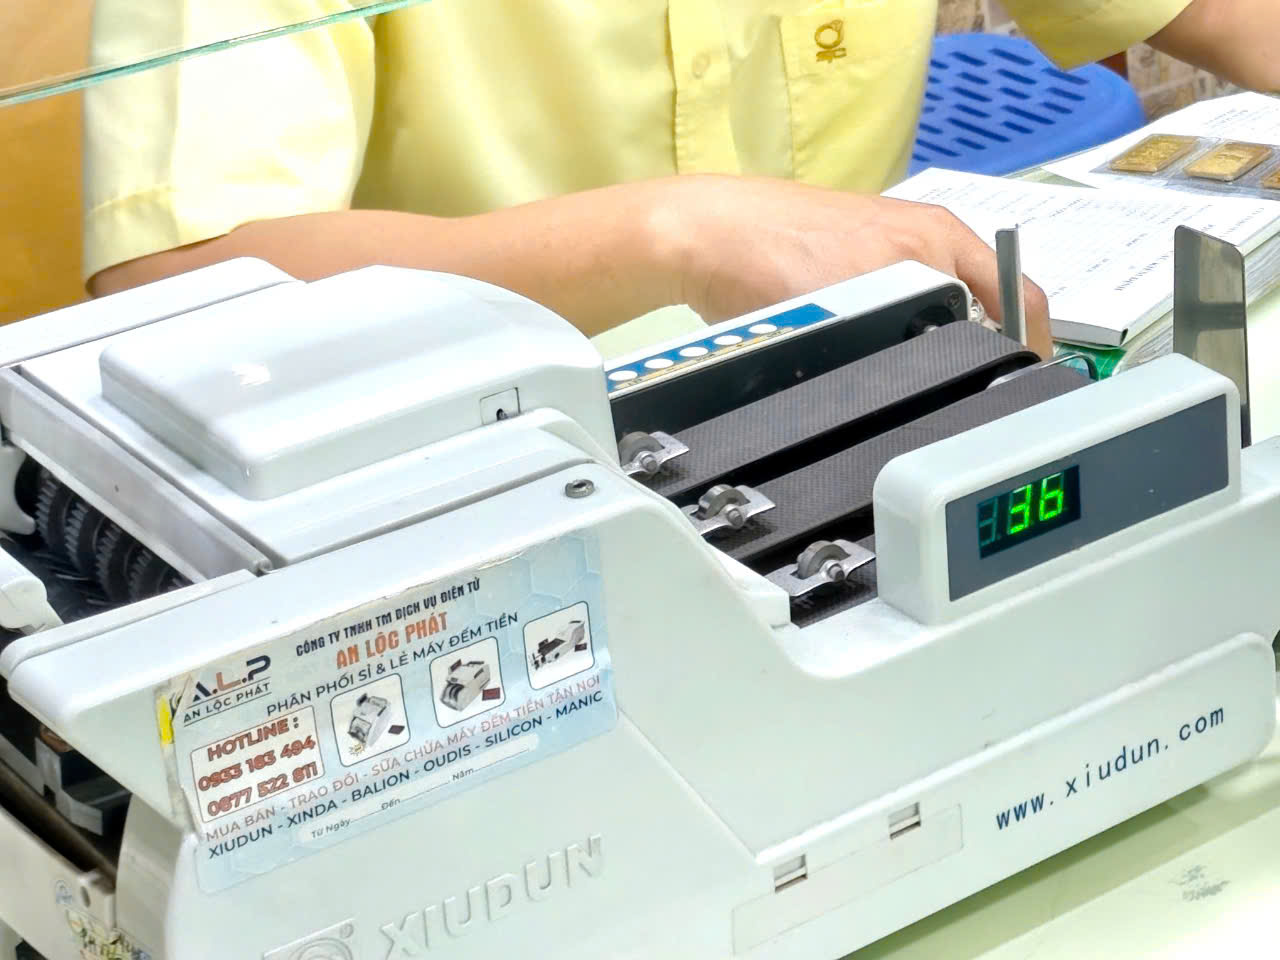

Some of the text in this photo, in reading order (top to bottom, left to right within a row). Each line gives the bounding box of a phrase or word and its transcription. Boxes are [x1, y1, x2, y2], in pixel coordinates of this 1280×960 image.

[1007, 472, 1065, 535] 36
[296, 635, 325, 657] CÔNG
[328, 631, 341, 646] TY
[344, 620, 373, 641] TNHH
[376, 612, 392, 627] TM
[396, 601, 420, 622] DỊCH
[423, 595, 437, 611] VỤ
[467, 576, 481, 594] TỬ
[336, 611, 448, 670] AN LỘC PHÁT
[316, 672, 354, 698] PHỐI
[358, 667, 371, 681] SỈ
[376, 662, 386, 674] &
[390, 653, 409, 670] LẺ
[413, 640, 444, 662] MÁY
[449, 626, 482, 648] ĐẾM
[485, 611, 518, 633] TIỀN
[183, 682, 271, 723] AN LỘC PHÁT
[198, 763, 243, 791] 0933
[205, 818, 240, 843] MUA
[244, 805, 276, 827] BÁN
[289, 786, 329, 810] TRAO
[447, 723, 477, 747] MÁY
[481, 713, 511, 733] ĐẾM
[208, 824, 273, 859] XIUDUN
[286, 799, 338, 829] XINDA
[351, 769, 410, 802] BALION
[423, 743, 472, 773] OUDIS
[484, 715, 543, 748] SILICON
[555, 690, 603, 719] MANIC
[257, 773, 289, 798] 522
[292, 761, 318, 783] 811
[379, 833, 604, 960] XIUDUN
